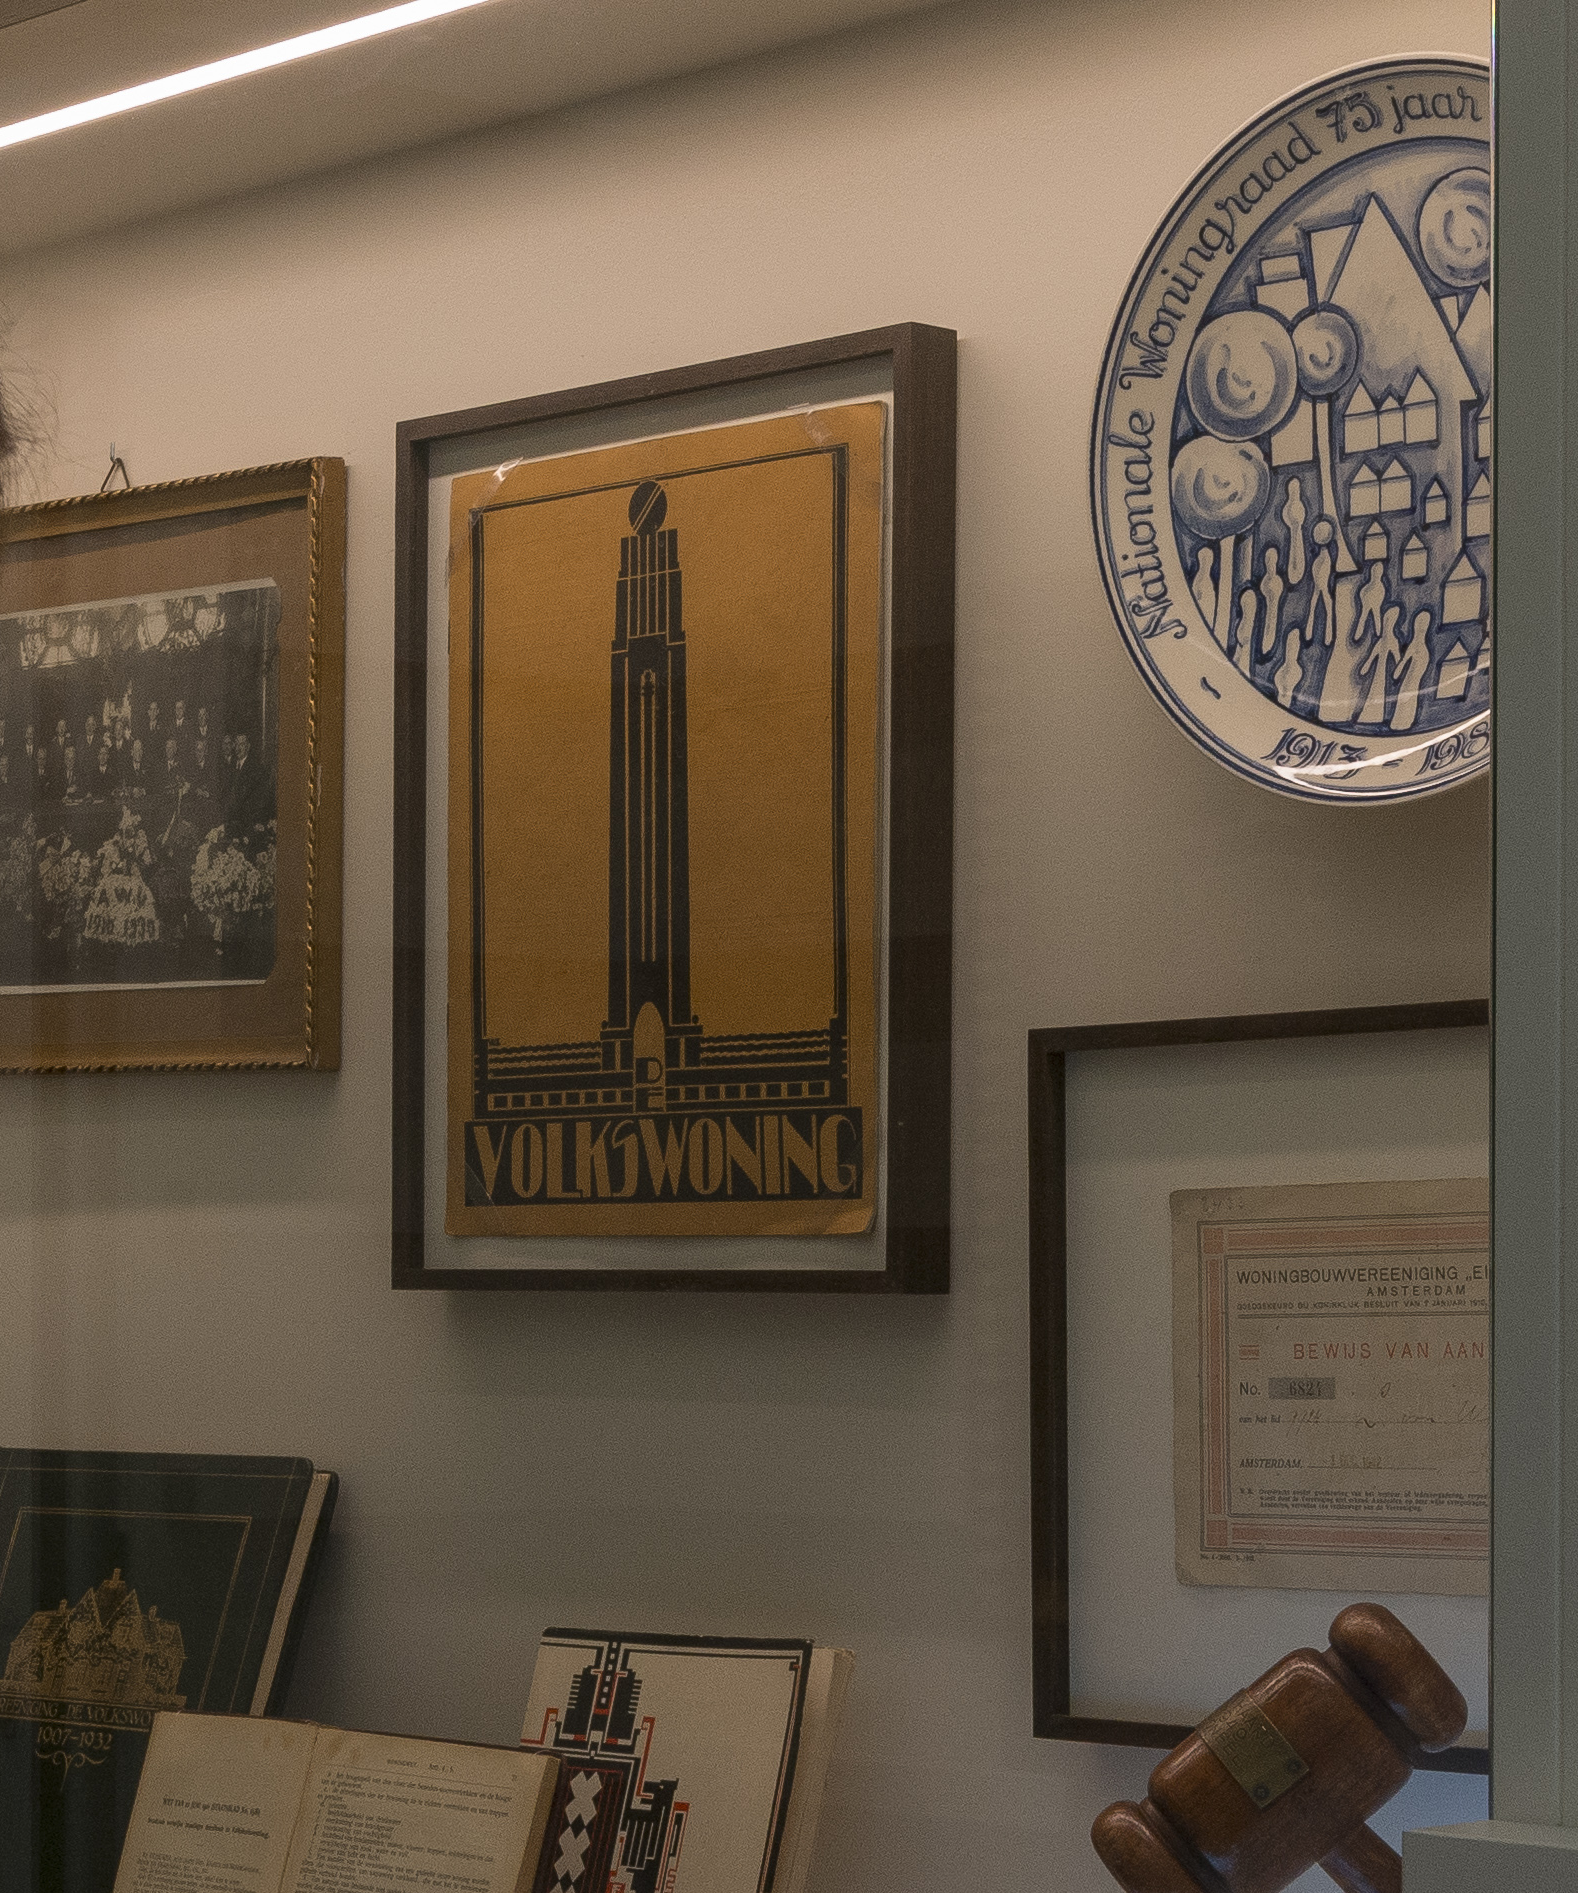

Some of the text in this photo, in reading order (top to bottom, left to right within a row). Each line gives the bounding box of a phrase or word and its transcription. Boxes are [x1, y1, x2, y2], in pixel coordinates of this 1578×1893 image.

[1109, 84, 1482, 640] Nationale Woningraad 75 jaar
[472, 1113, 858, 1200] VOLKSWONING
[1236, 1265, 1459, 1285] WONINGBOUWVEREENIGING
[1366, 1285, 1467, 1297] AMSTERDAM
[1292, 1341, 1373, 1361] BEWIJS
[1385, 1341, 1430, 1360] VAN
[1239, 1381, 1262, 1397] No.
